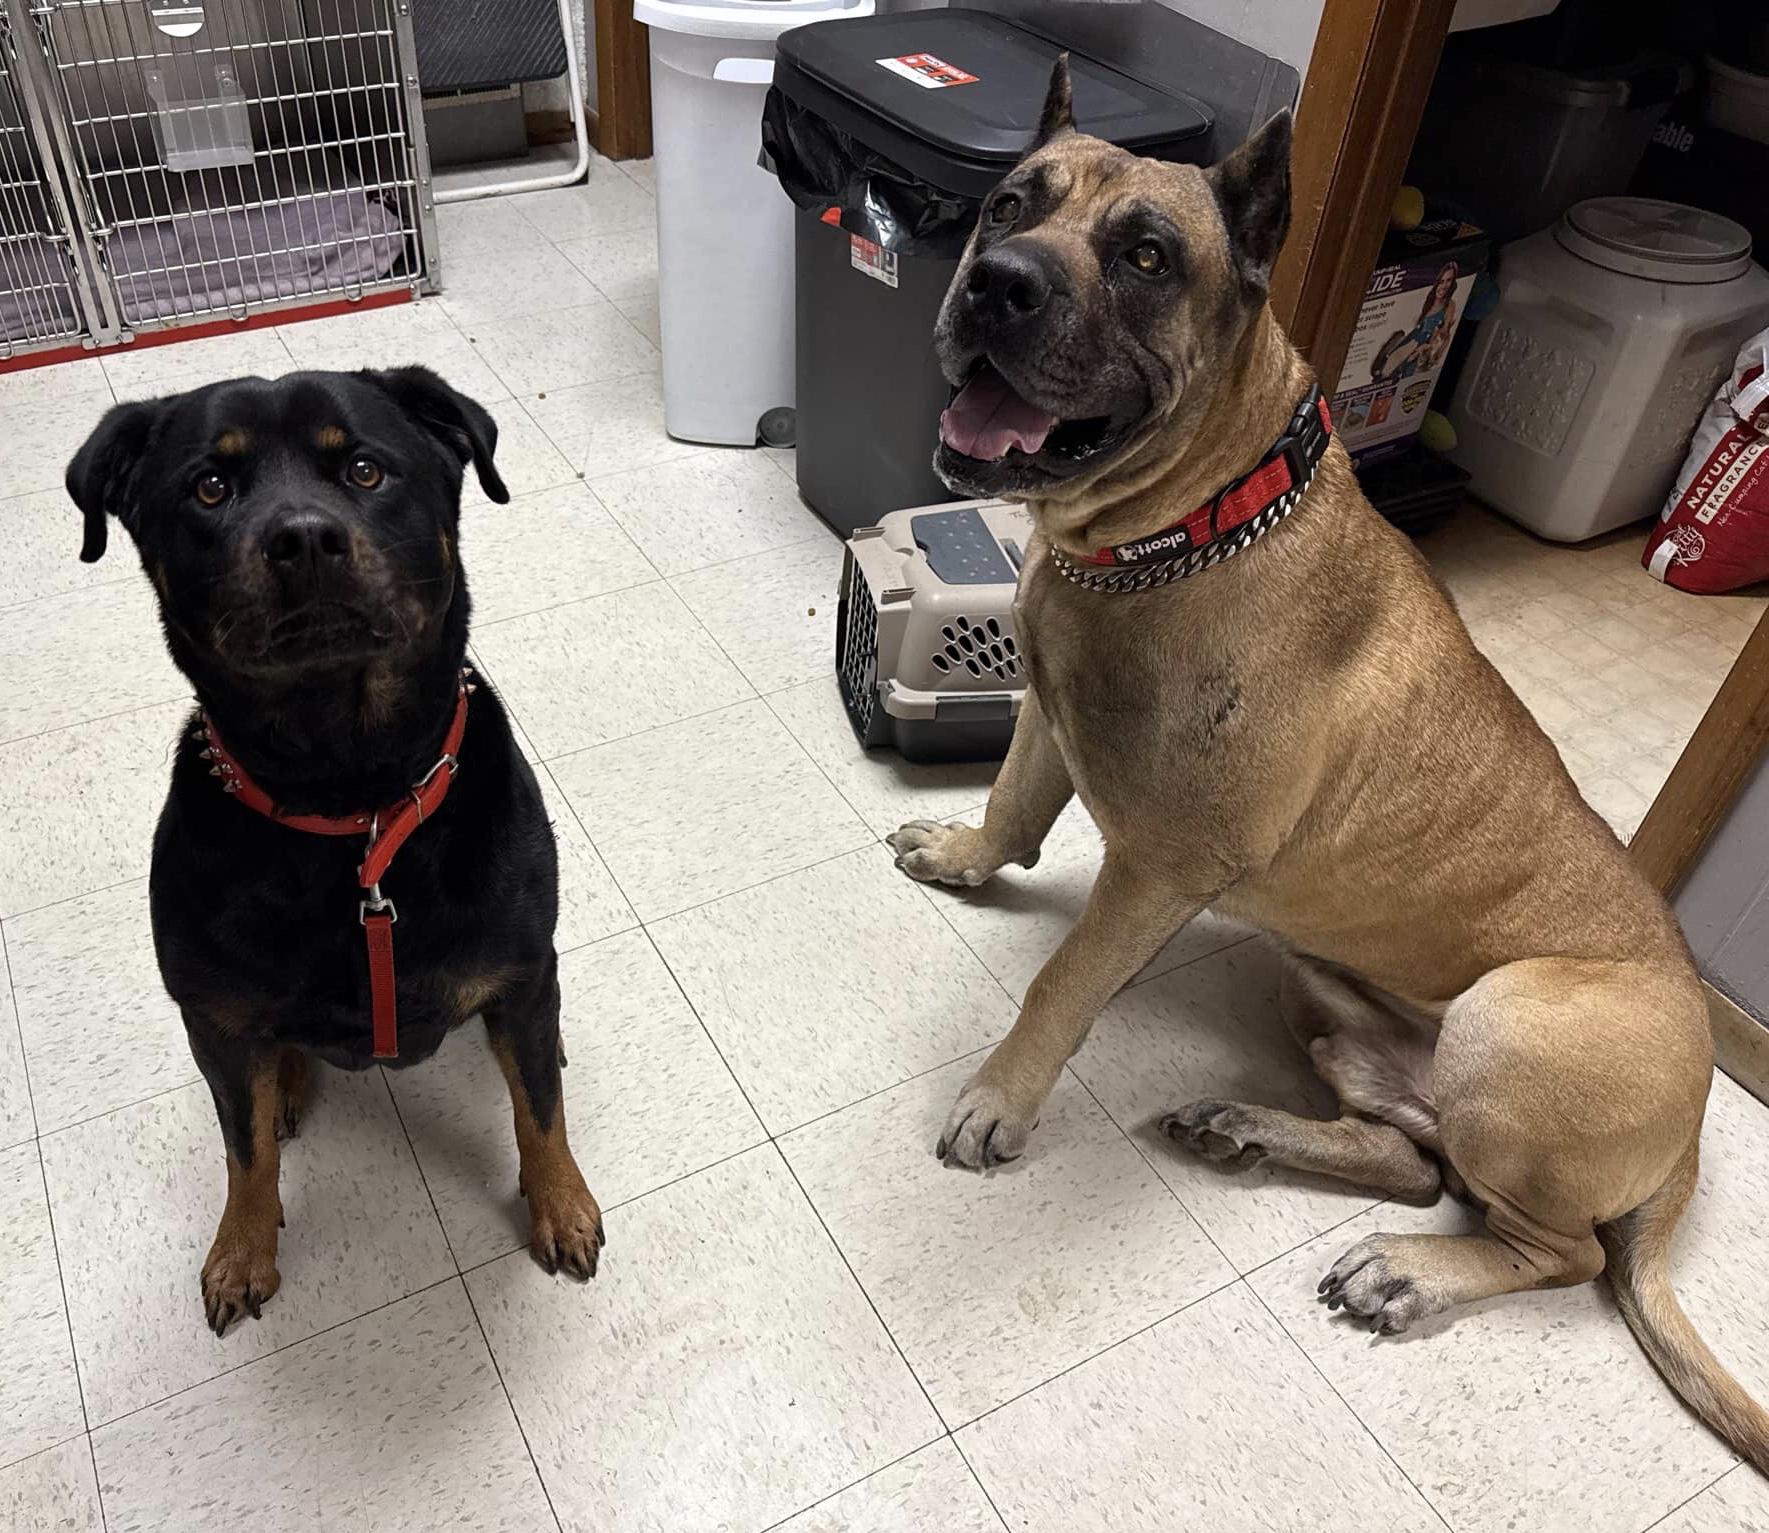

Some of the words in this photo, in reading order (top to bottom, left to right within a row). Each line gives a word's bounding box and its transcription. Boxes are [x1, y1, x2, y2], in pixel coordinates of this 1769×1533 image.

[1366, 270, 1407, 294] IDE
[1686, 433, 1752, 510] NATURAL
[1135, 532, 1186, 555] alcott
